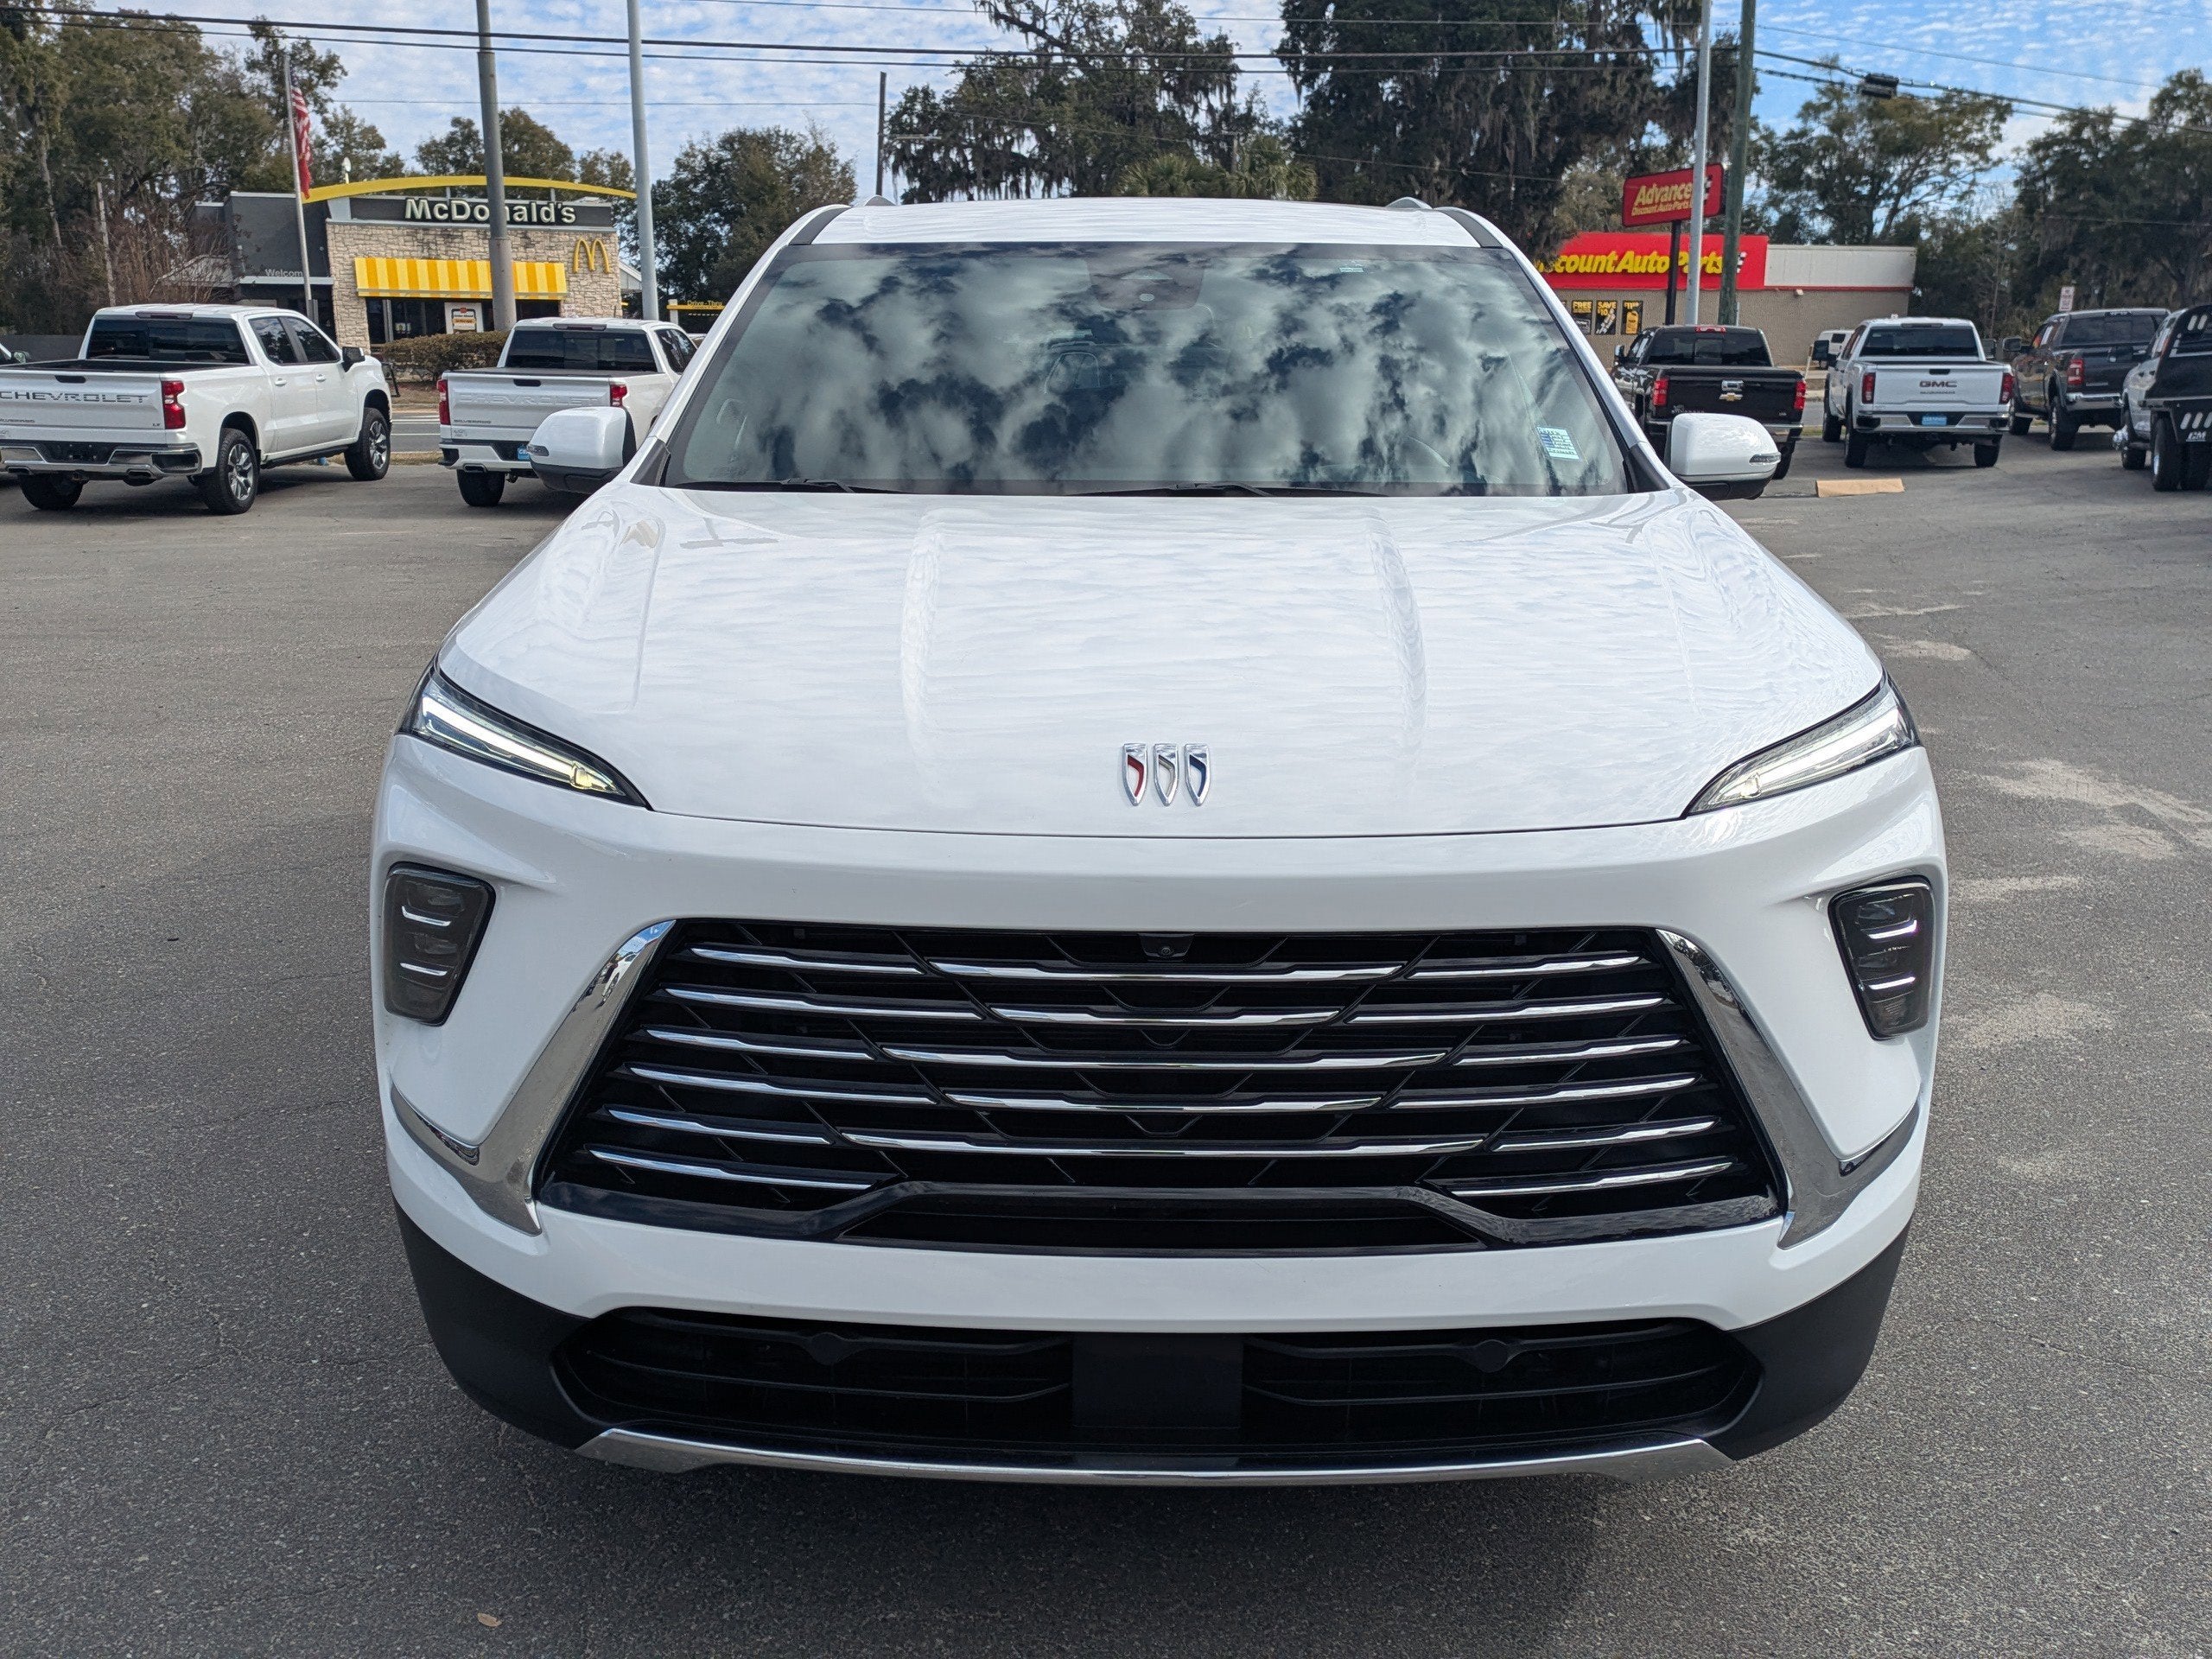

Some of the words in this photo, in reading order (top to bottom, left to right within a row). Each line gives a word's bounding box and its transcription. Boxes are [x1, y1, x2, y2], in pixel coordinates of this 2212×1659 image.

[1635, 182, 1693, 207] Advance
[404, 198, 576, 224] McDoald's
[1631, 205, 1657, 216] Discount
[1657, 202, 1674, 213] Auto
[1614, 251, 1670, 273] Auto
[264, 268, 303, 277] Welcom
[1573, 301, 1592, 309] FREE
[0, 391, 148, 404] CHEVROLET
